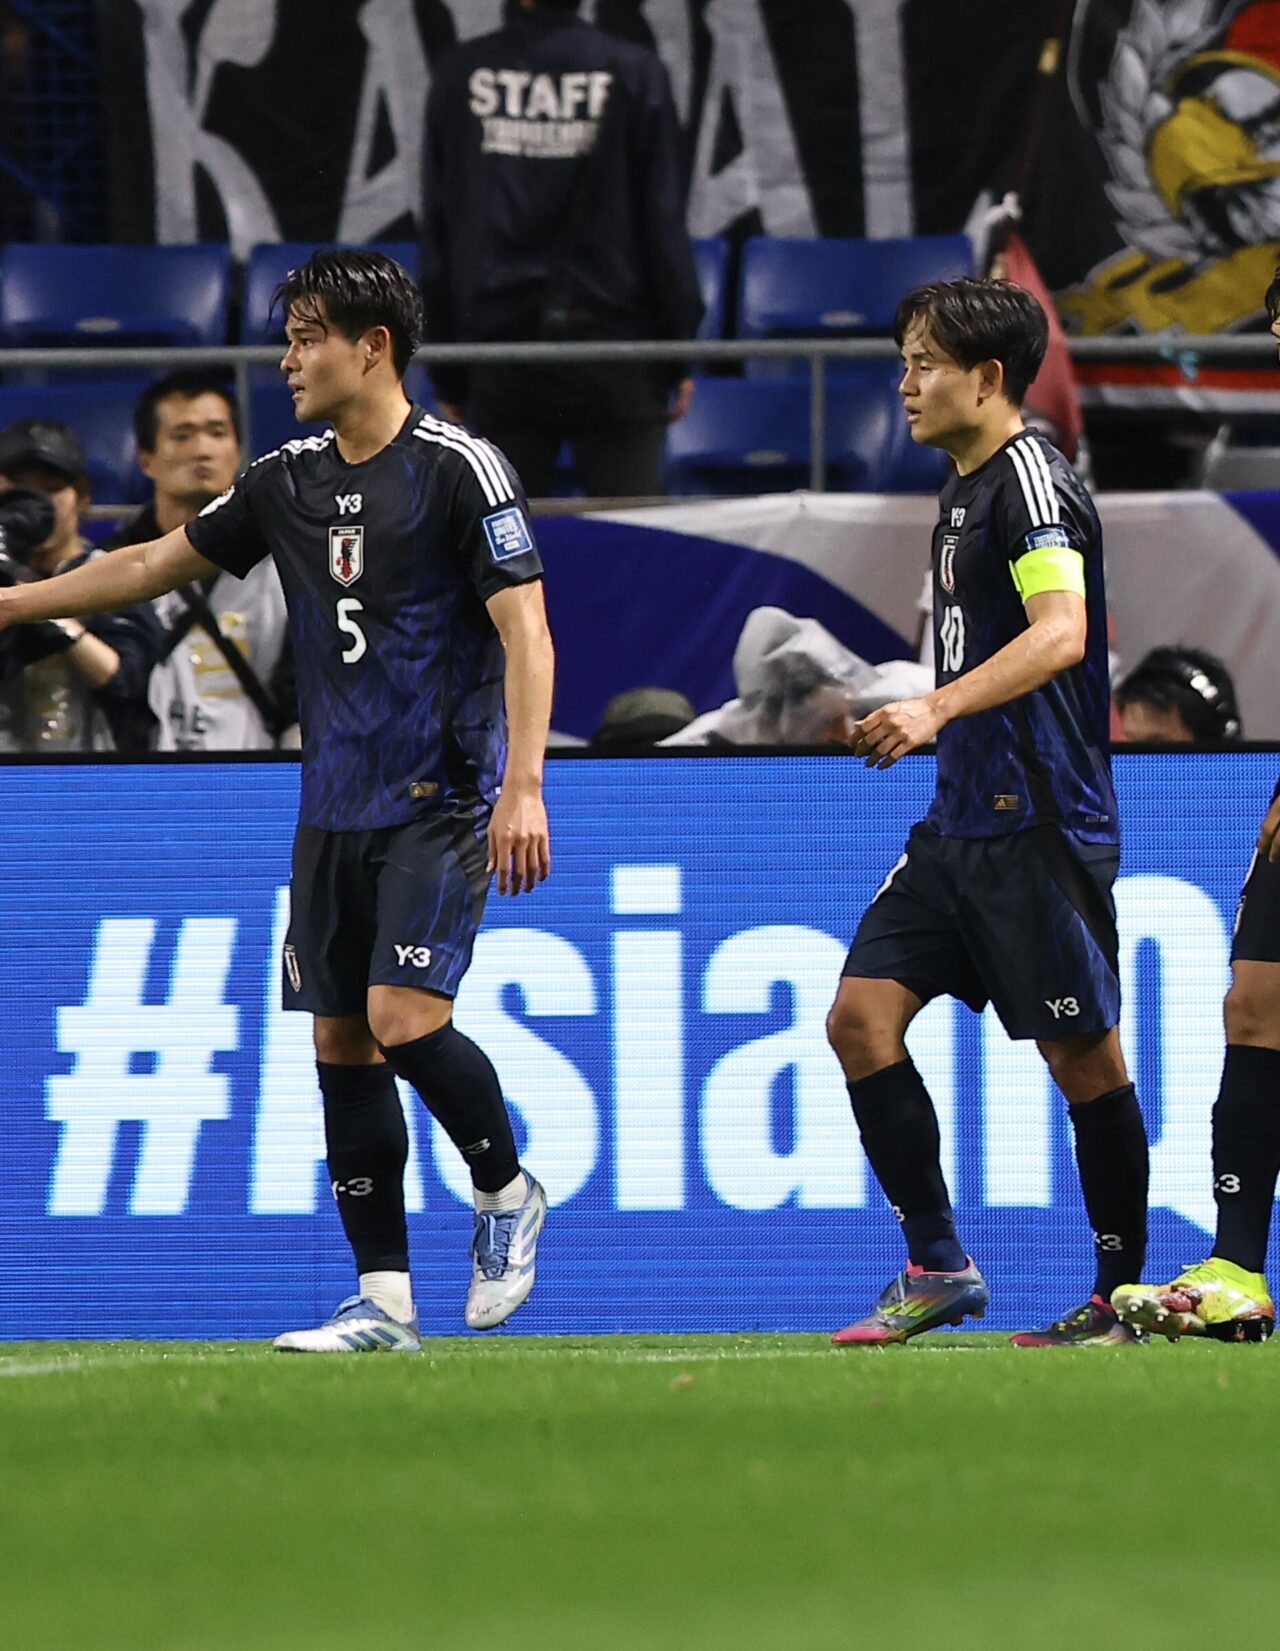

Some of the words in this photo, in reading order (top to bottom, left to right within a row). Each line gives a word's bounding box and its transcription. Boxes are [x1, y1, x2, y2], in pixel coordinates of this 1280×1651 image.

[468, 67, 613, 119] STAFF
[335, 493, 363, 516] Y-3
[336, 598, 367, 664] 5
[940, 605, 966, 673] 10
[393, 944, 432, 968] Y-3
[1044, 996, 1080, 1019] Y-3
